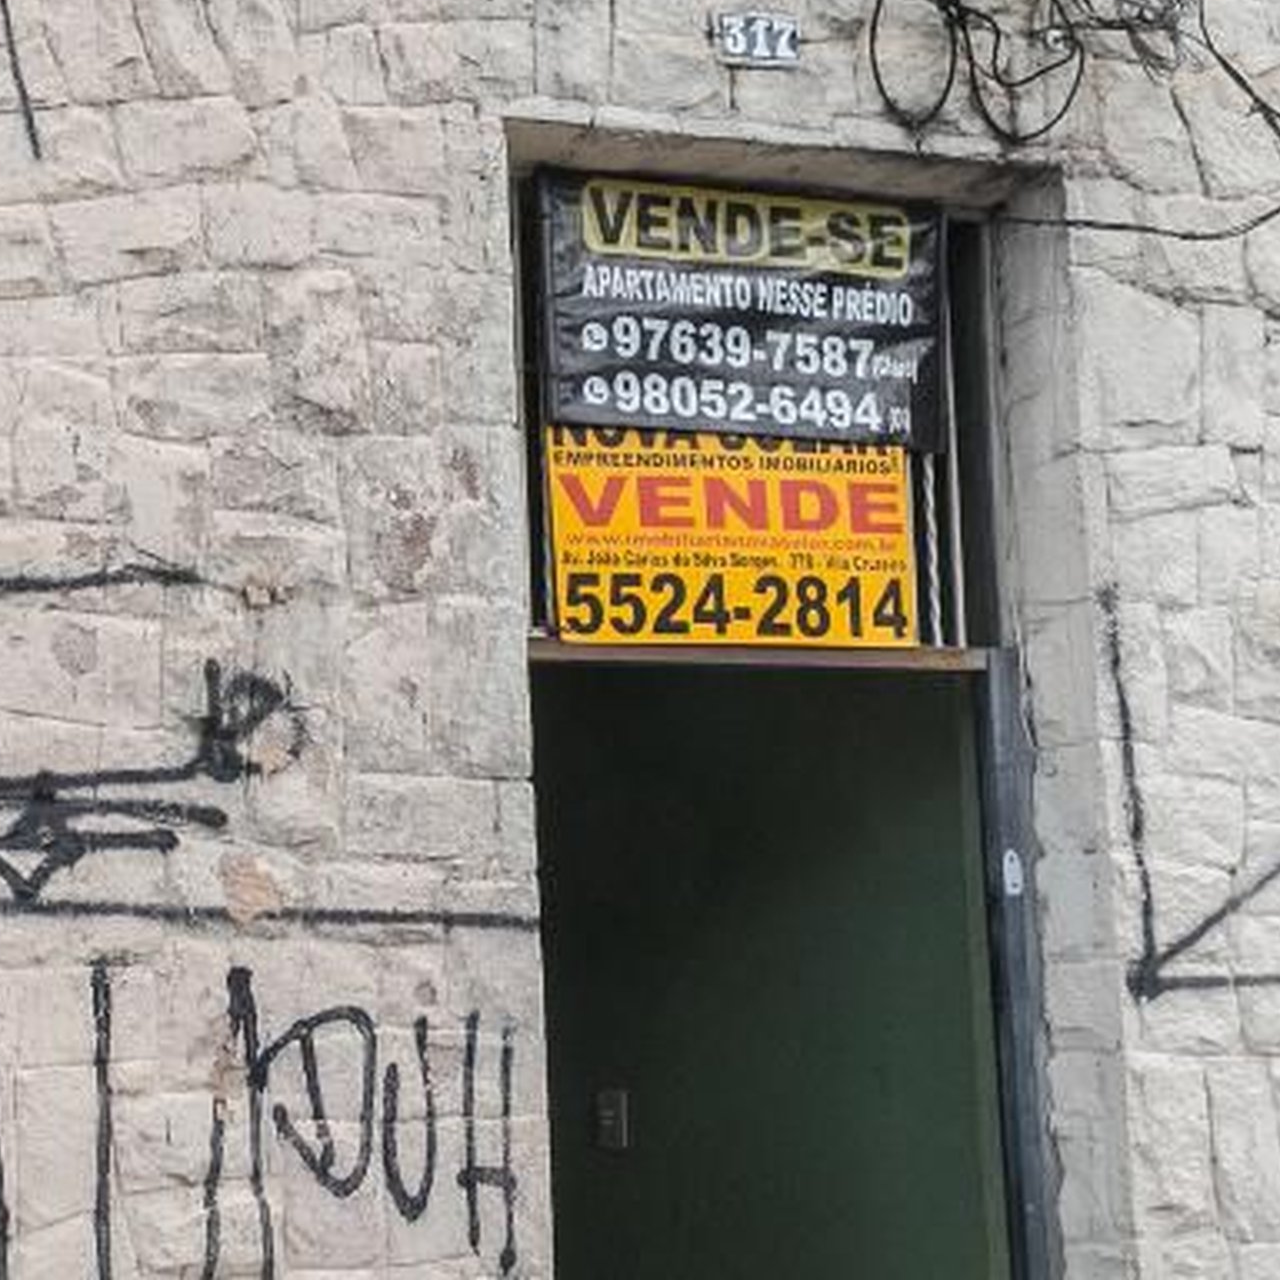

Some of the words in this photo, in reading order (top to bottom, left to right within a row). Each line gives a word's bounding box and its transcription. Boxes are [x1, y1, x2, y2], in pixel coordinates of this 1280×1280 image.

[721, 17, 797, 57] 317
[589, 186, 908, 270] VENDE-SE
[581, 265, 752, 310] APARTAMENTO
[758, 275, 827, 319] NESSE
[832, 282, 915, 327] PRÉDIO
[612, 315, 874, 379] 97639-7587
[612, 370, 883, 432] 98052-6494
[553, 451, 755, 472] EMPREENDIMENTOS
[558, 473, 904, 534] VENDE
[565, 573, 908, 639] 5524-2814
